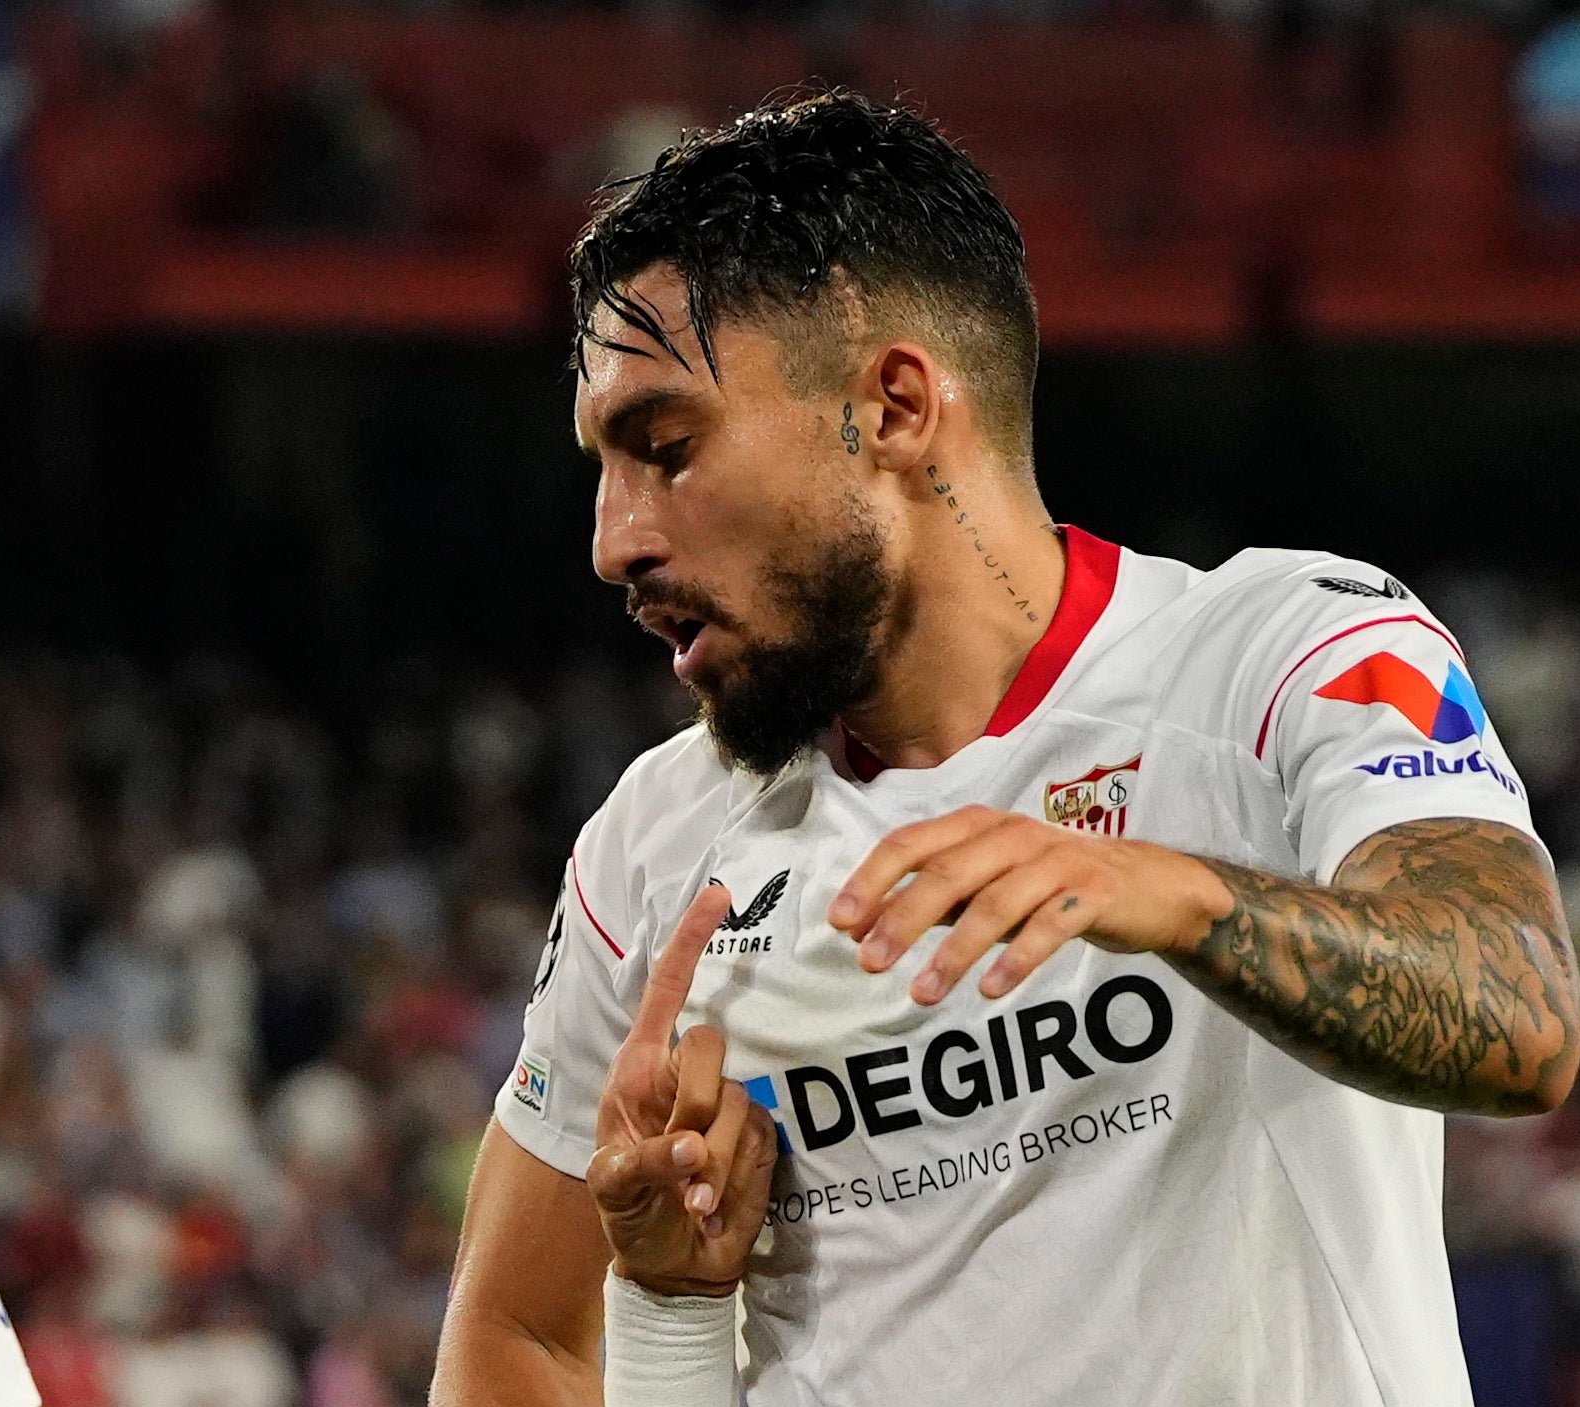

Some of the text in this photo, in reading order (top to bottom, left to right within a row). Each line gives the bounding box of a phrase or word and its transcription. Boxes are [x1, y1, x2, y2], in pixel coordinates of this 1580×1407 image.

[705, 936, 772, 955] ASTORE
[784, 974, 1174, 1152] DEGIRO
[877, 1141, 1011, 1203] LEADING
[1020, 1094, 1173, 1165] BROKER
